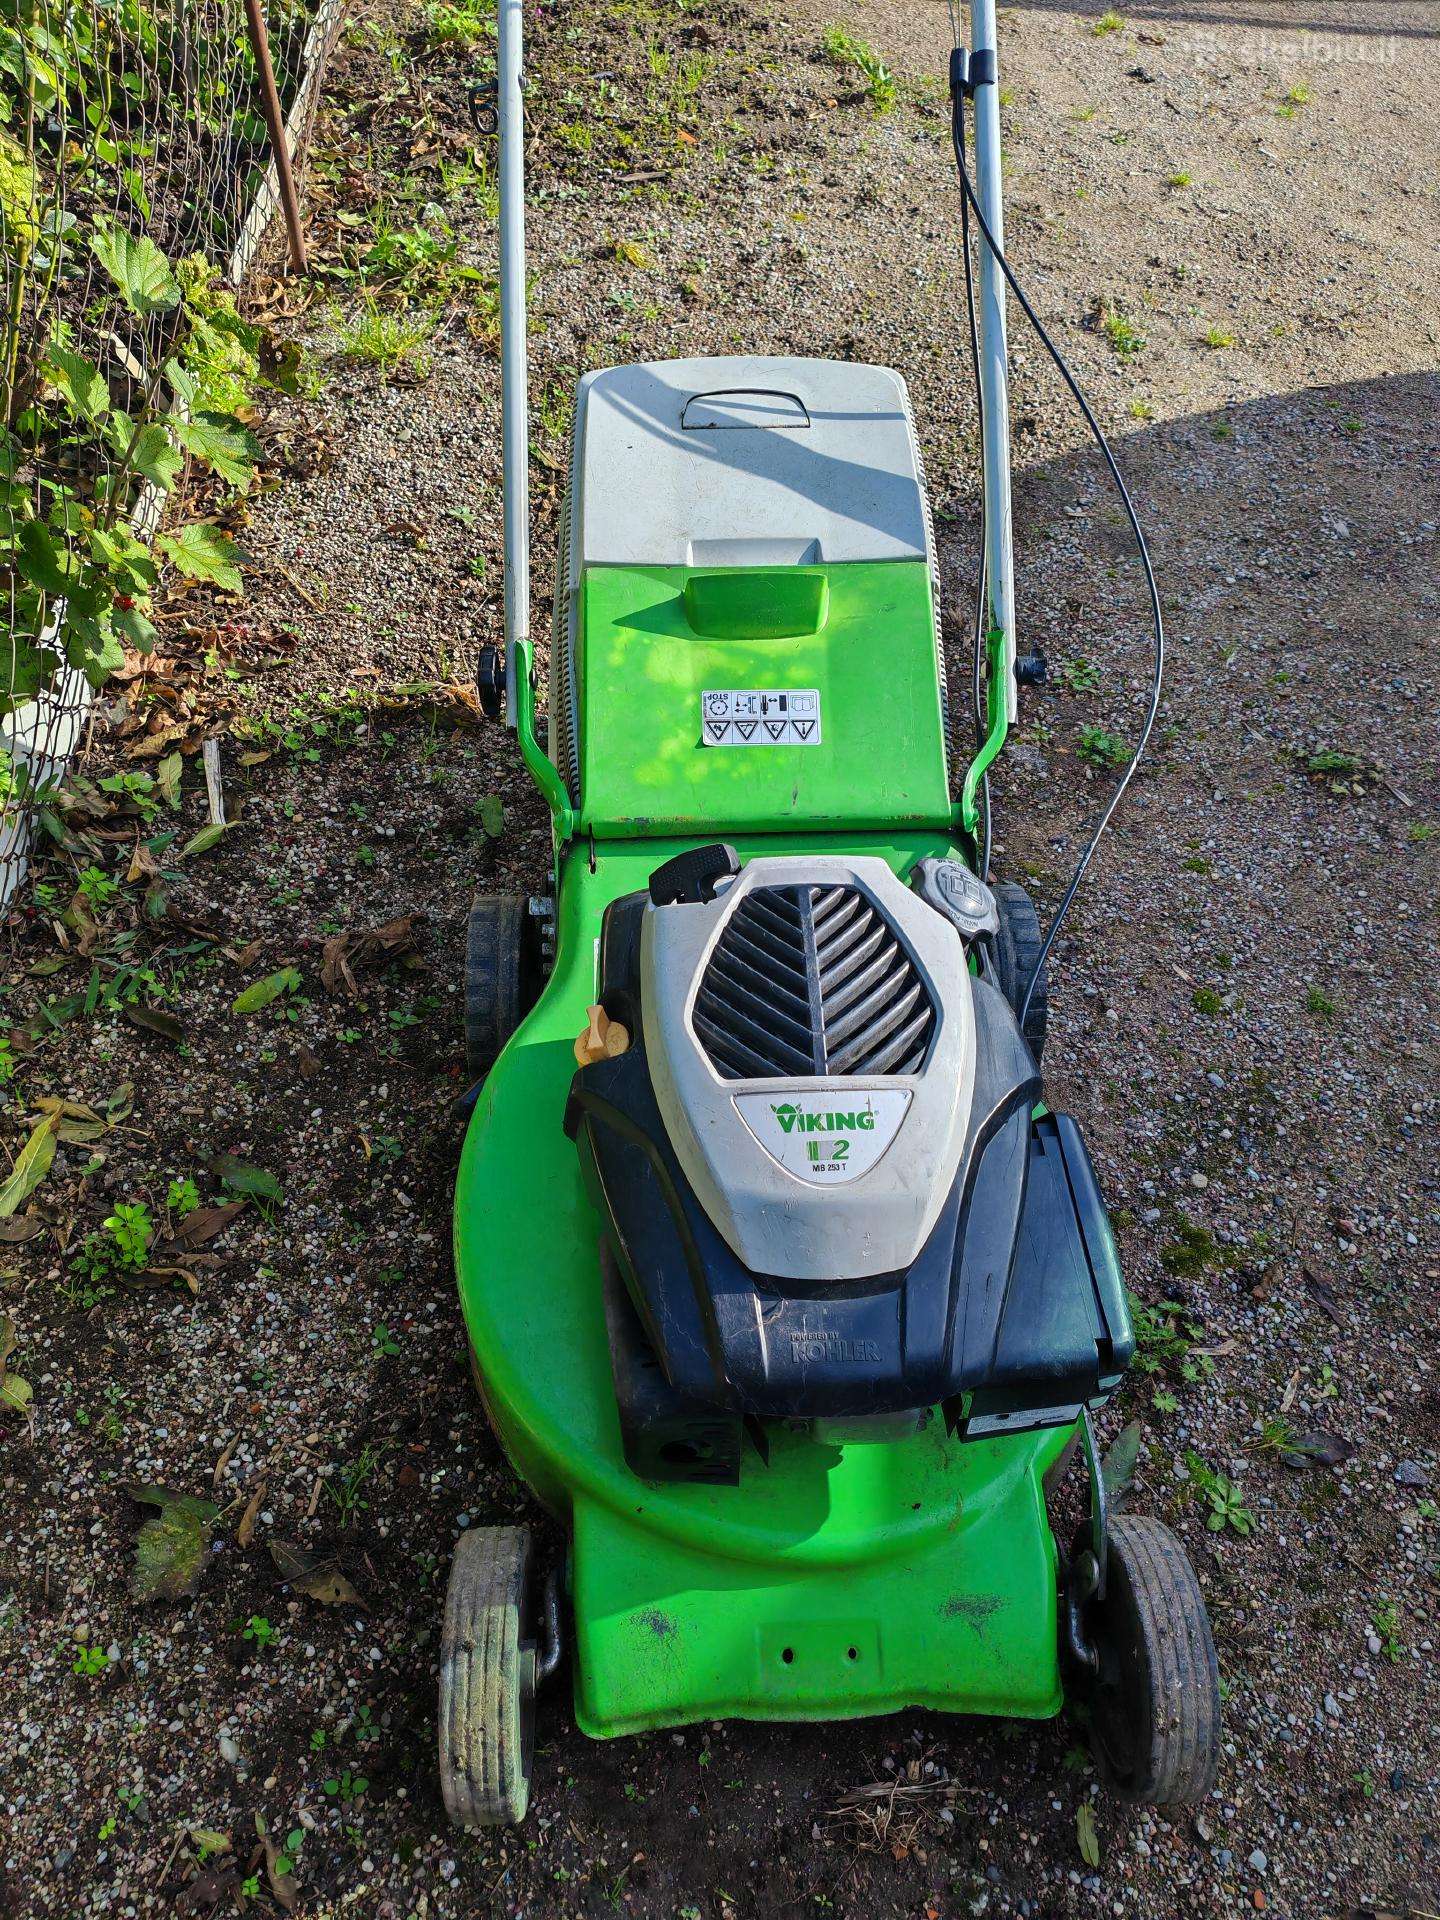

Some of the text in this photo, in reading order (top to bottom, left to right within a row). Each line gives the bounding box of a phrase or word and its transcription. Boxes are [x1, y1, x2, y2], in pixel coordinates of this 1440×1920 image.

[775, 1109, 875, 1133] VIKING
[812, 1163, 847, 1172] MB 253 T
[790, 1332, 840, 1341] POWERED BY
